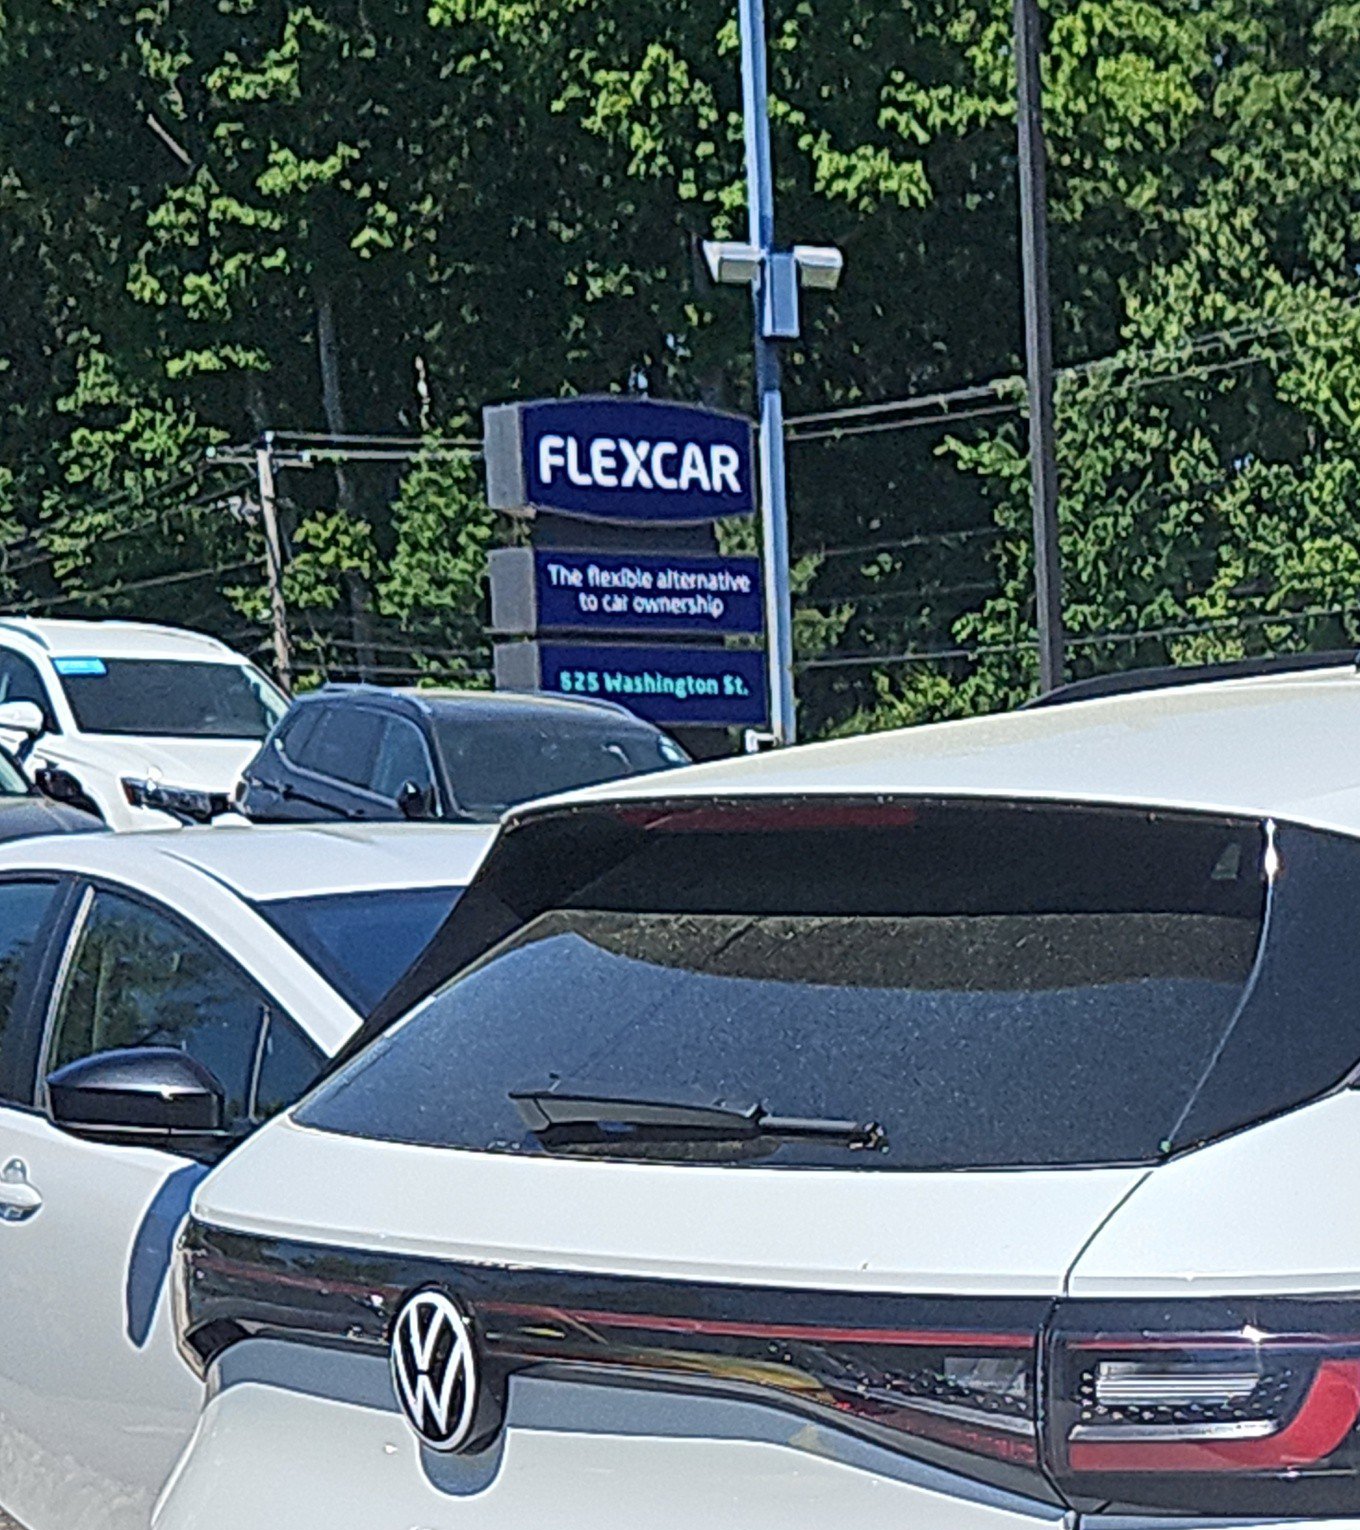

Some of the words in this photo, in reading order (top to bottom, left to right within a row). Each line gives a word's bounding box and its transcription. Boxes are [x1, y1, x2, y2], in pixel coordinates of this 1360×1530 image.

[539, 434, 742, 493] FLEXCAR
[547, 563, 583, 587] The
[587, 564, 654, 589] flexible
[656, 567, 751, 593] alternative
[578, 591, 599, 612] to
[602, 593, 629, 613] car
[632, 593, 725, 619] ownership
[560, 670, 600, 692] 525
[603, 670, 719, 699] Washington
[723, 674, 749, 696] St.
